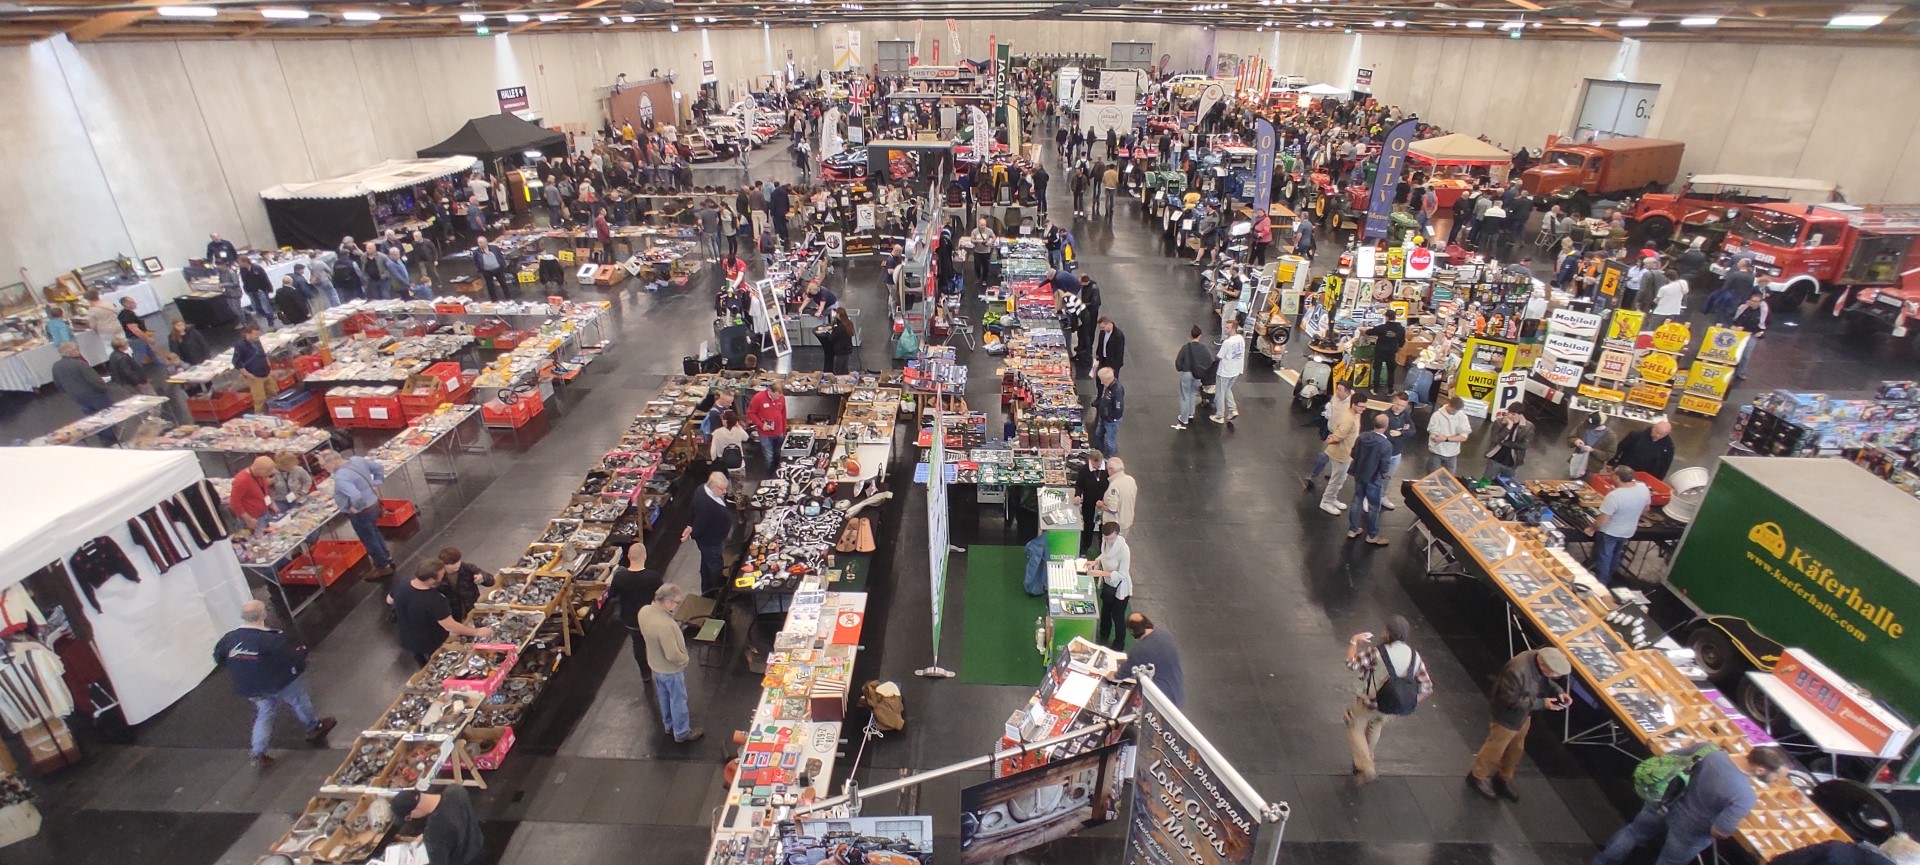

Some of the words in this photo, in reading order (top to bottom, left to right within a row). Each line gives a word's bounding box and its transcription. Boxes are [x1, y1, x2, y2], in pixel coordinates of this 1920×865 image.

[500, 89, 515, 99] HALLE
[997, 58, 1006, 108] JAGUAR
[1379, 137, 1406, 203] OTLV
[1555, 313, 1597, 326] Mobiloil
[1655, 331, 1686, 343] SHELL
[1548, 339, 1589, 352] Mobiloil
[1541, 371, 1570, 383] super
[1643, 361, 1673, 376] SHELL
[1500, 386, 1518, 409] P
[1746, 551, 1868, 642] www.kaeferhalle.com
[1787, 546, 1904, 639] Käferhalle
[1795, 669, 1842, 713] BERU
[1145, 712, 1163, 735] Alex
[1163, 732, 1194, 771] Chessa
[1193, 766, 1251, 835] Photograph
[1150, 759, 1184, 803] Lost
[1185, 799, 1226, 857] Cars
[1160, 794, 1184, 821] and
[1163, 816, 1205, 865] More
